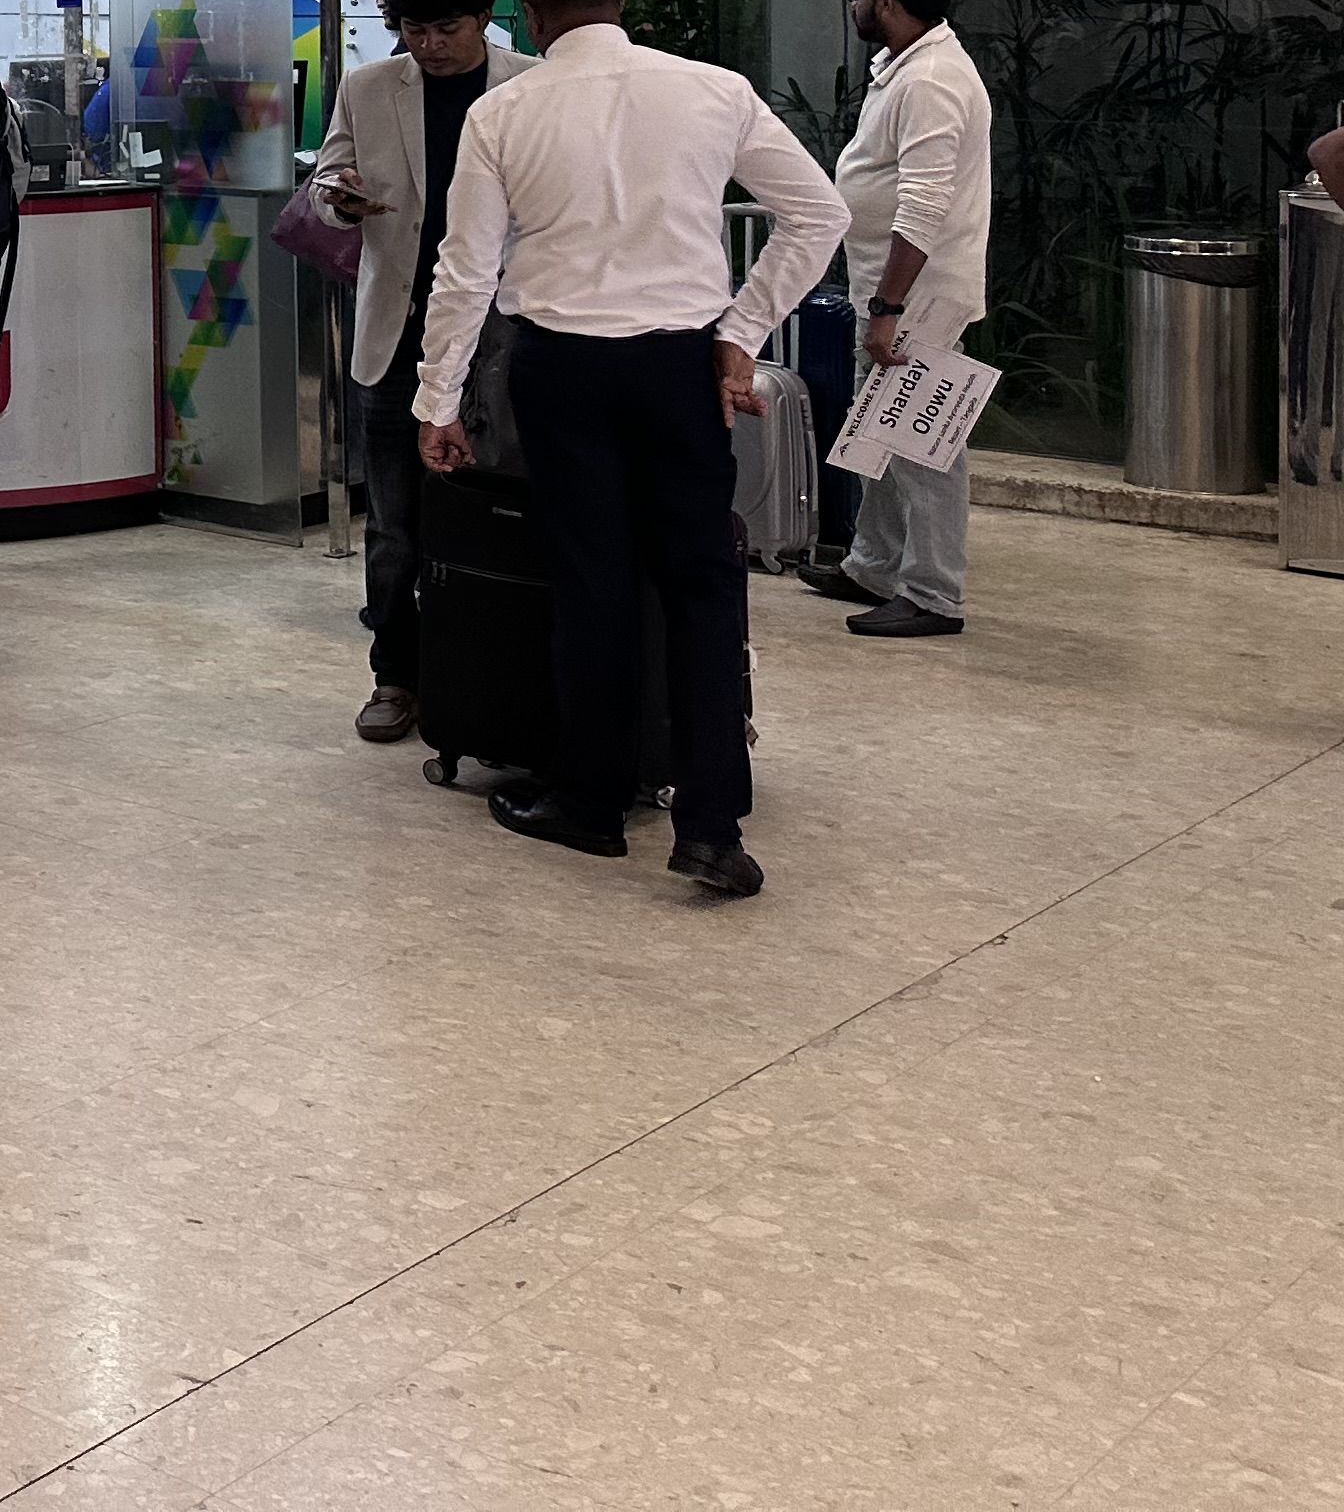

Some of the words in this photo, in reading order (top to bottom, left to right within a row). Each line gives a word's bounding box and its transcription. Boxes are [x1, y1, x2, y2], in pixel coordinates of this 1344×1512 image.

[845, 393, 873, 438] WELCOME
[890, 330, 910, 356] ANKA
[879, 358, 930, 429] Sharday
[912, 378, 954, 435] Olowu
